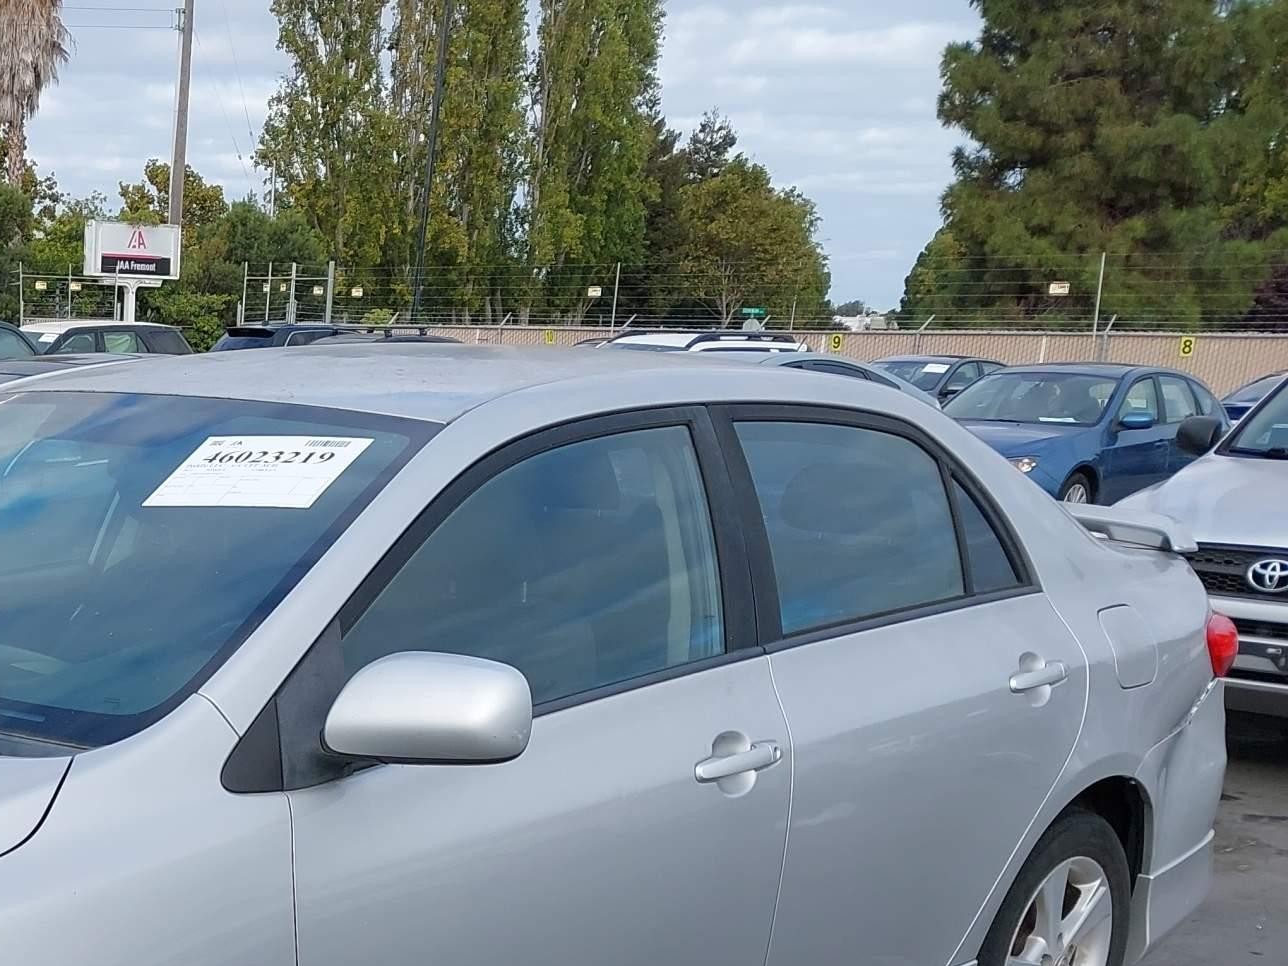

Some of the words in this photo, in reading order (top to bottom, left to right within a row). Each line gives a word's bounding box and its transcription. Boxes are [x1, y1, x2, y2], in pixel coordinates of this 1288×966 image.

[130, 260, 156, 271] Fremont
[833, 336, 841, 349] 9
[1182, 339, 1192, 354] 8
[202, 450, 336, 465] 46023219
